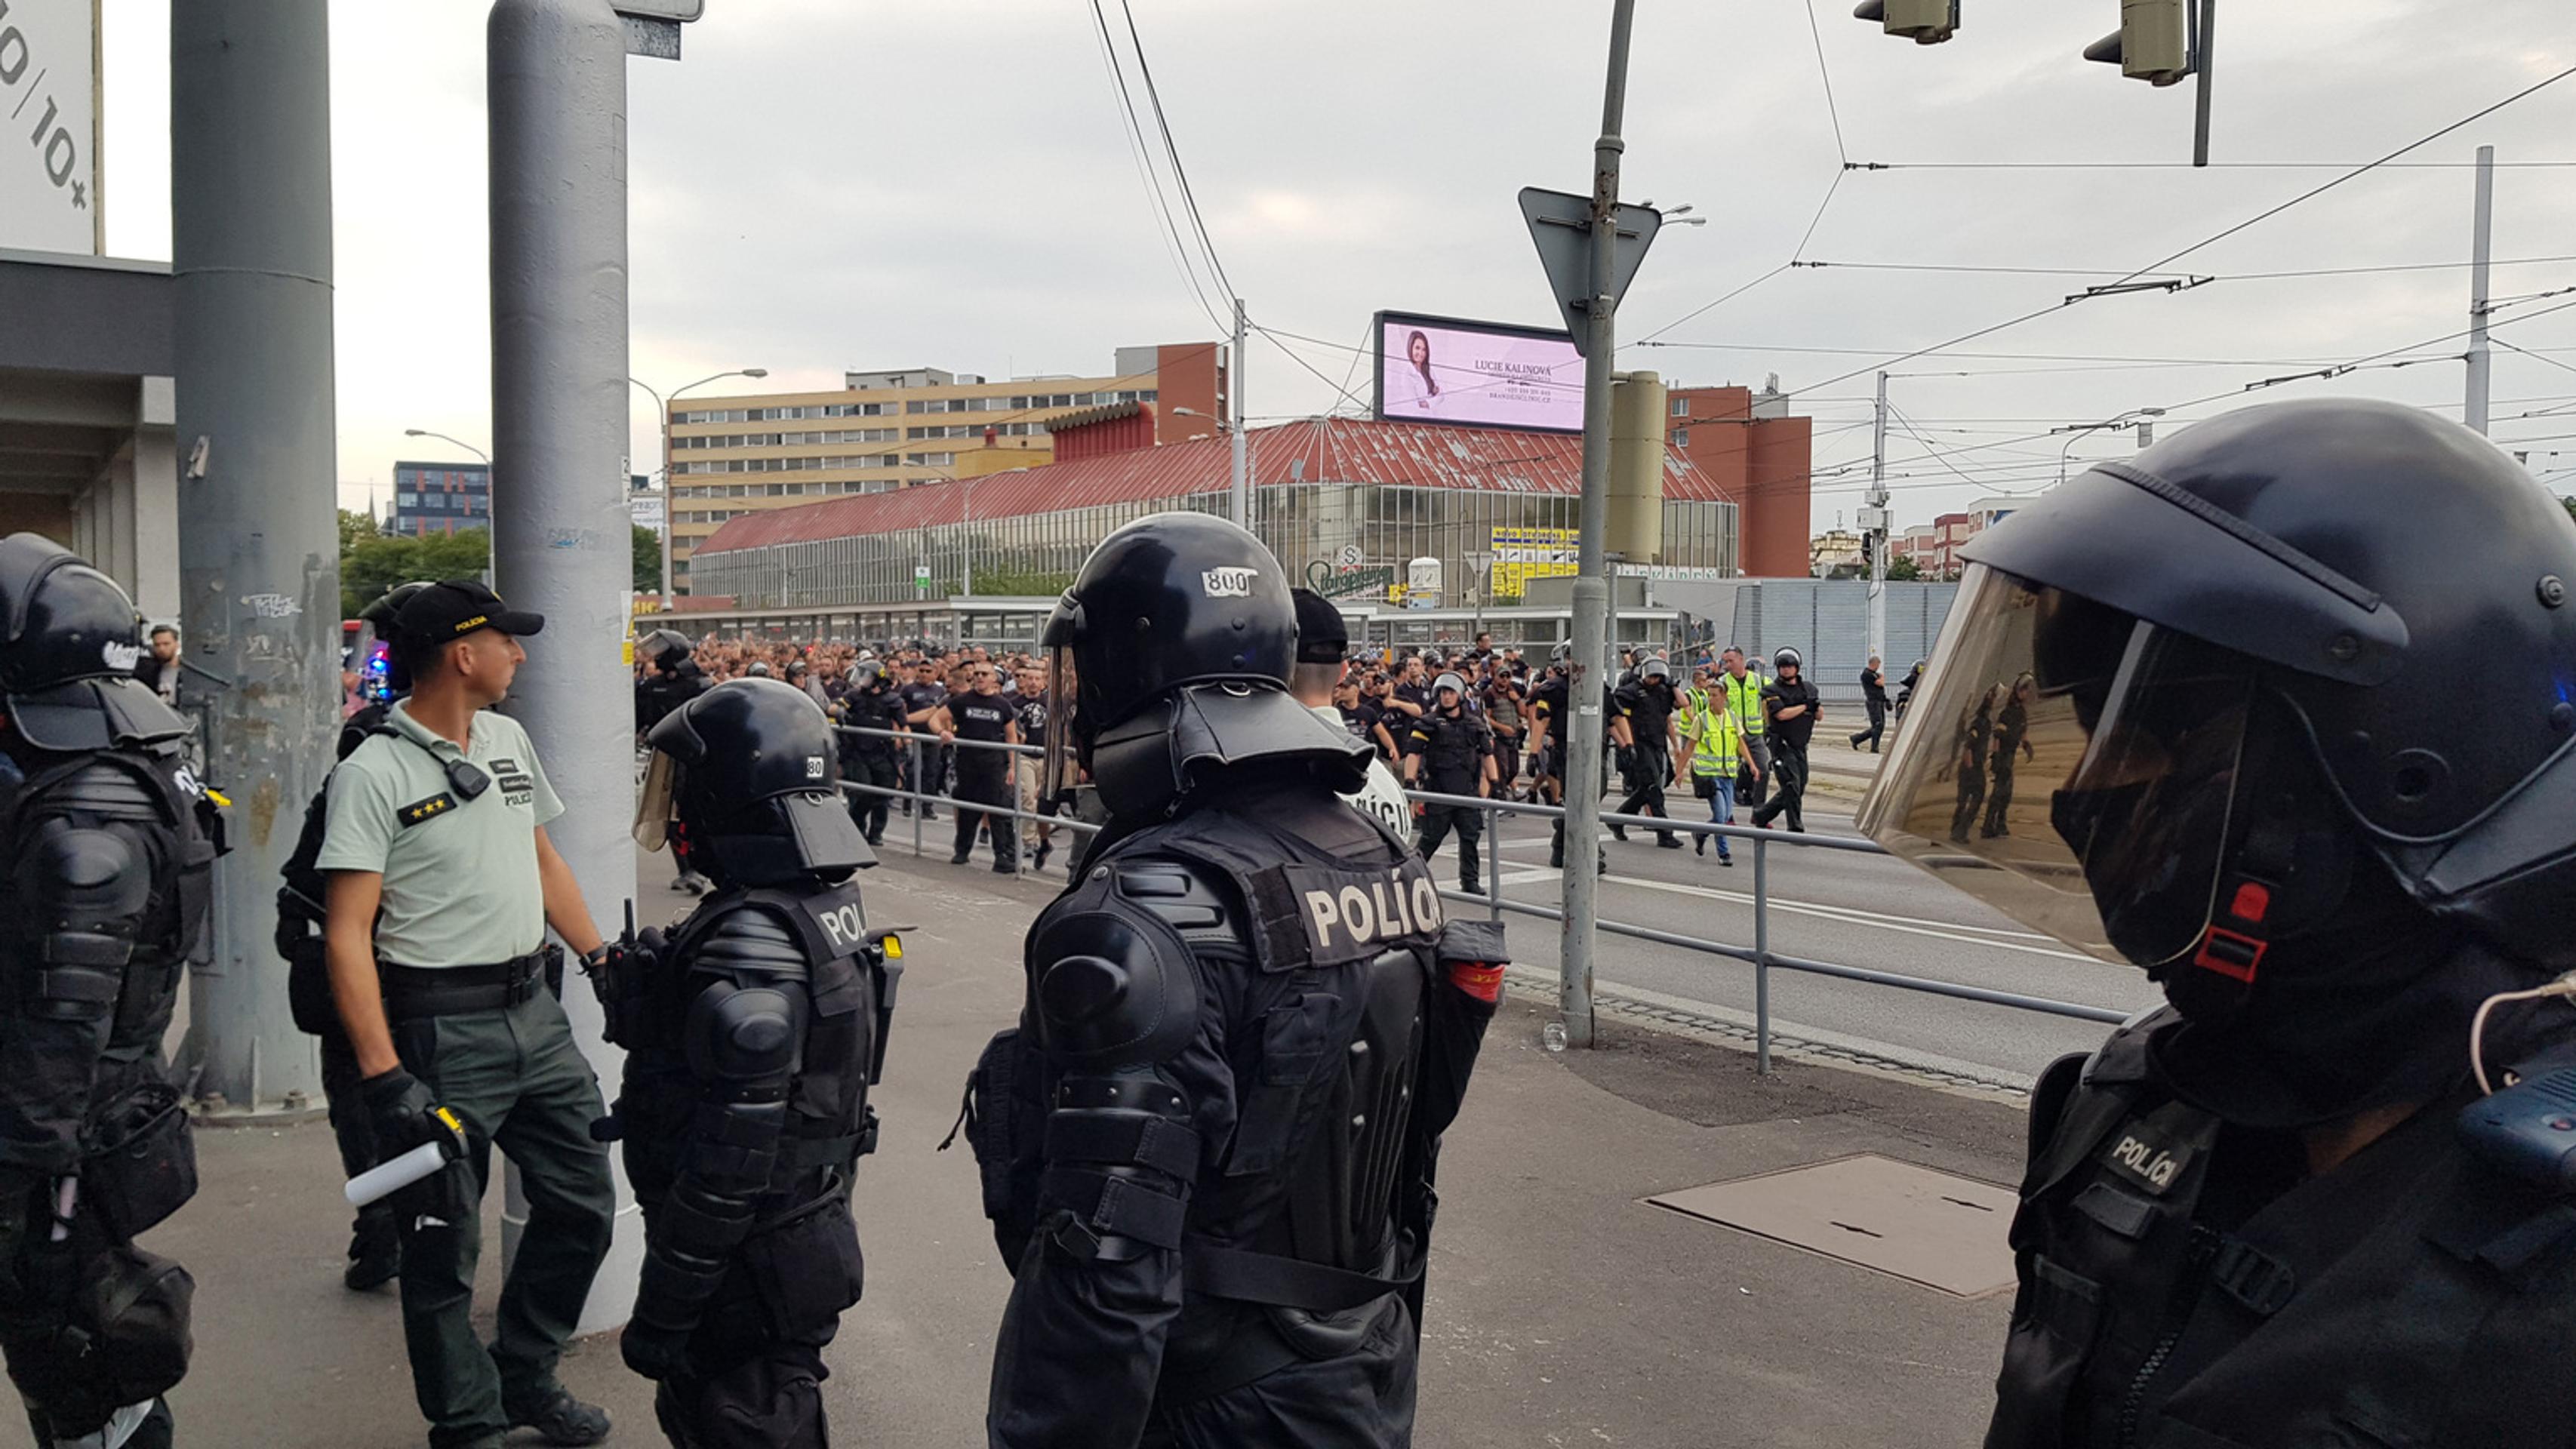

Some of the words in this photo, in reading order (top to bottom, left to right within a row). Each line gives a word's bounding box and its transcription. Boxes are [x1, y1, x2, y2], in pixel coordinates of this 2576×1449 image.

[1475, 359, 1503, 372] LUCIE
[1504, 363, 1552, 377] KALINOVÁ
[1208, 572, 1248, 591] 800
